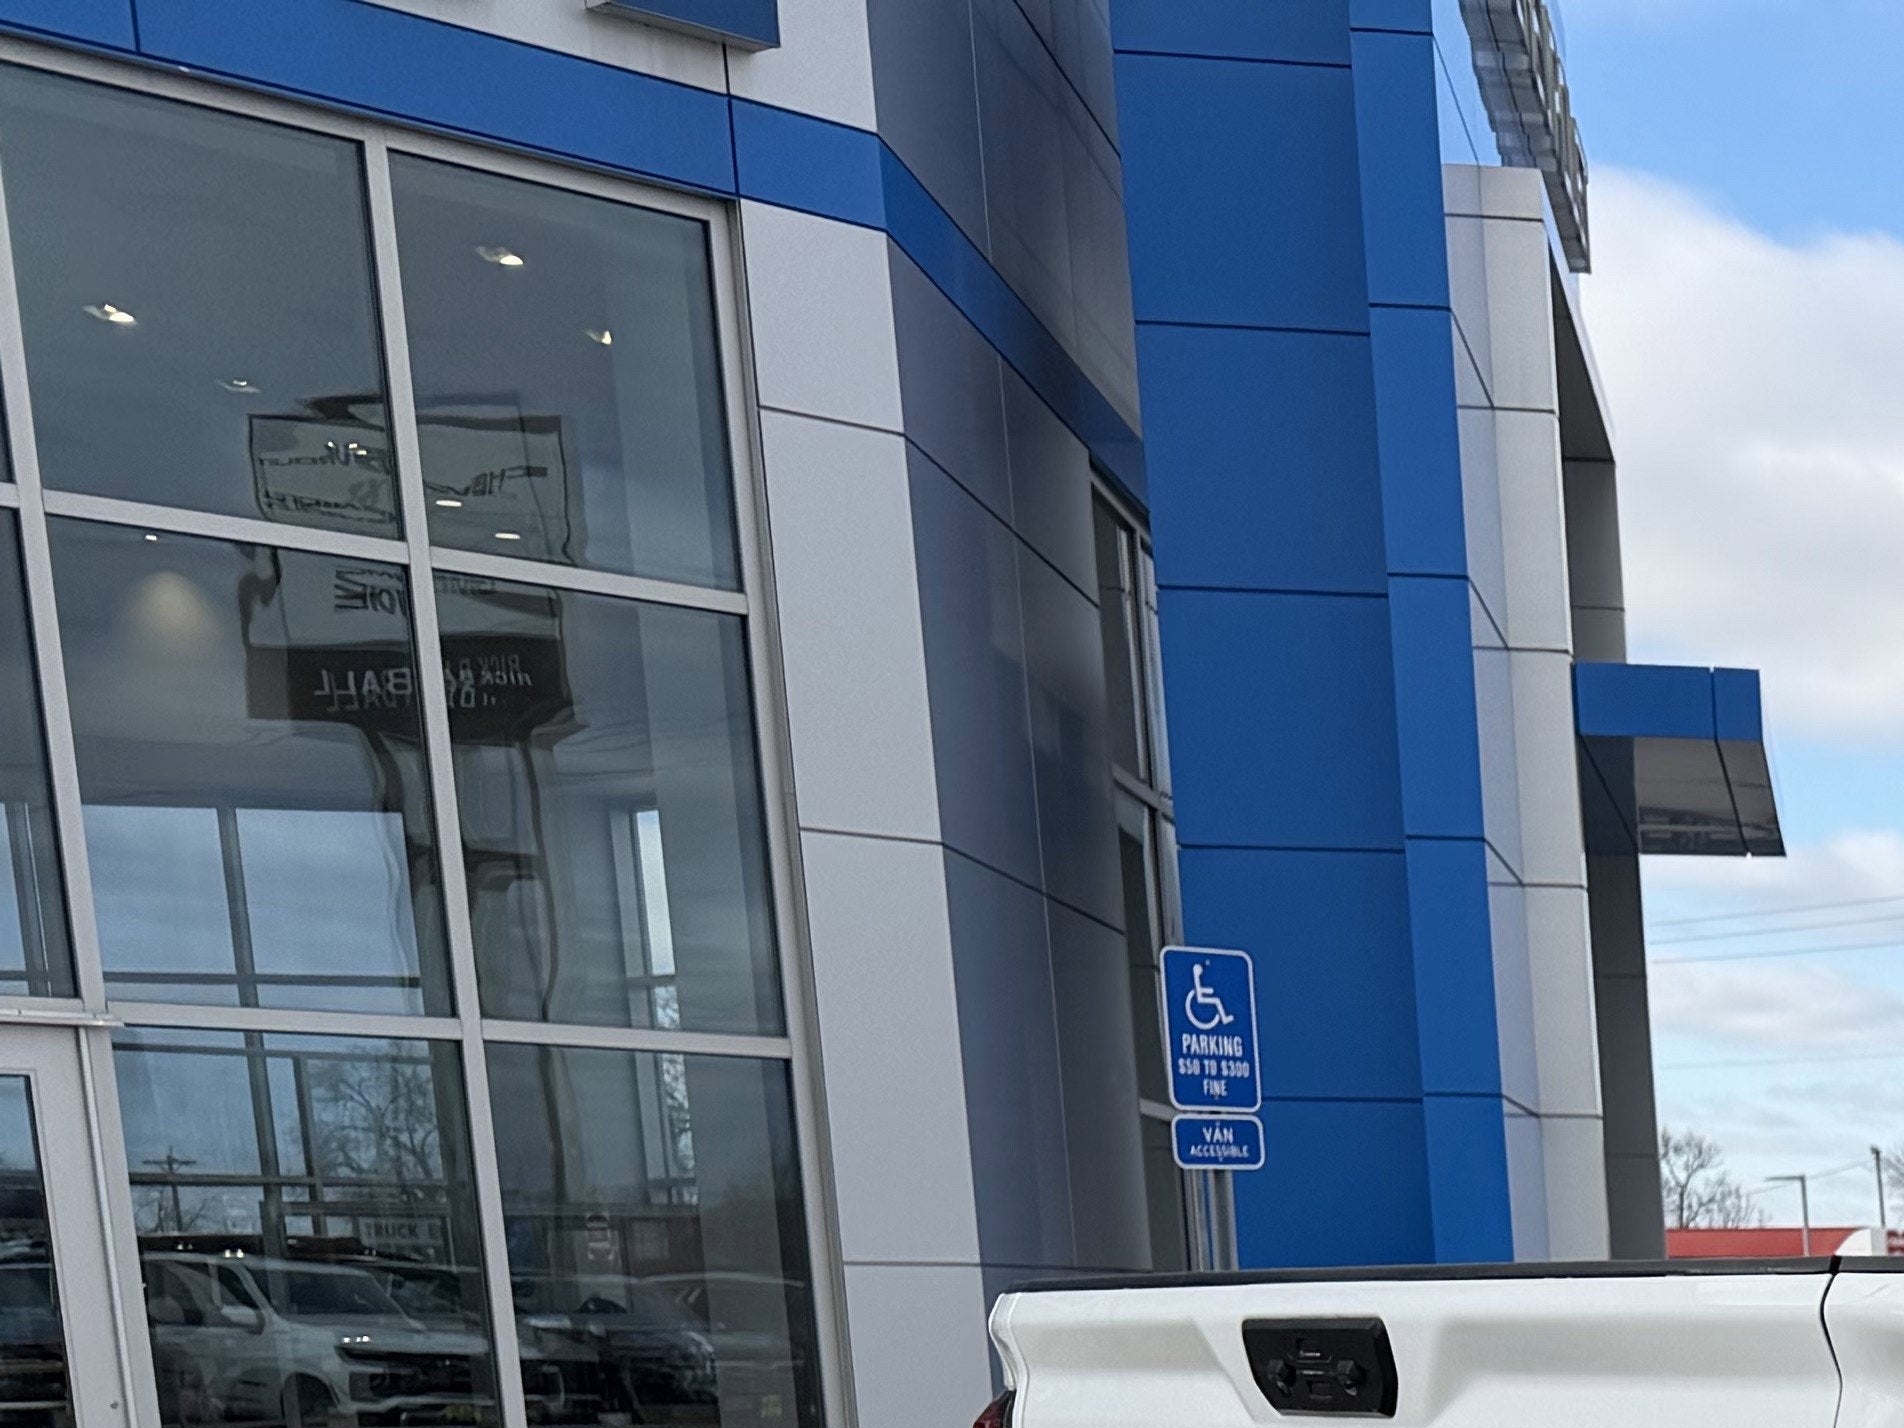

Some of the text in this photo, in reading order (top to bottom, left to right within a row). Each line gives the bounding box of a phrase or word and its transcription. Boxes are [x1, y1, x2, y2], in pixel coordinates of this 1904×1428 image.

[1181, 1033, 1243, 1057] PARKING
[1203, 1059, 1218, 1076] TO
[1203, 1078, 1228, 1096] FINE
[1202, 1126, 1234, 1144] VAN
